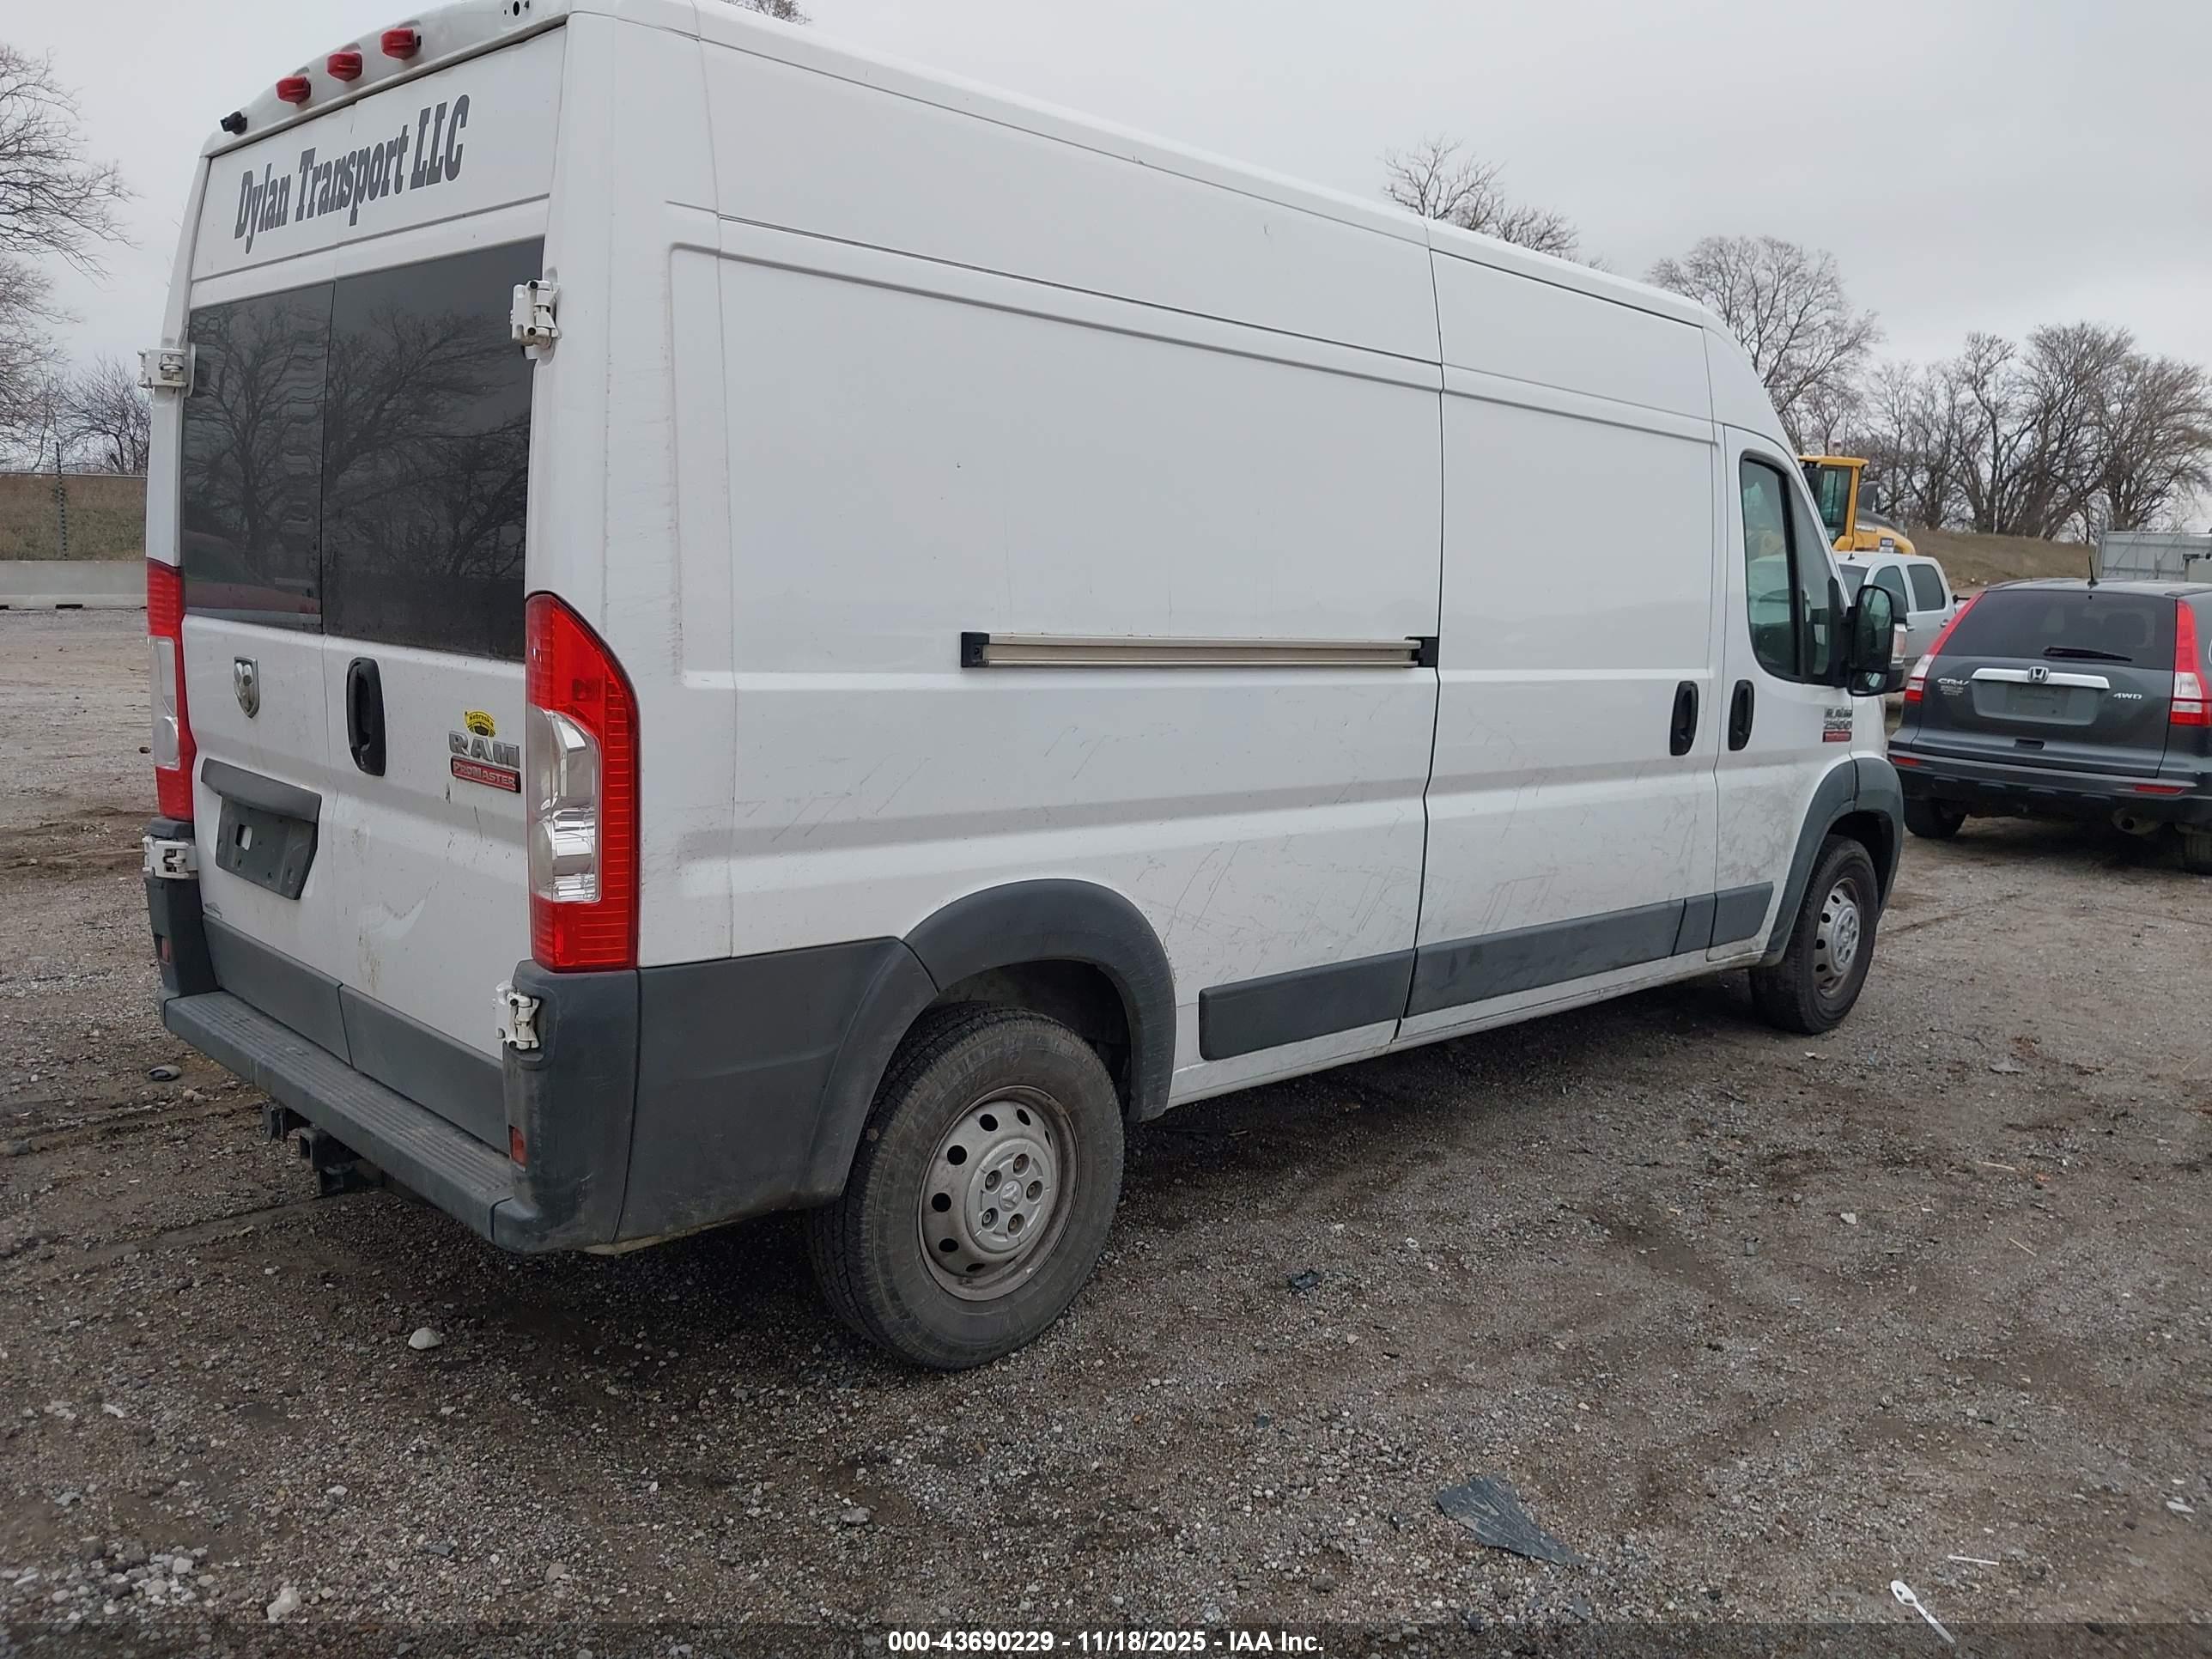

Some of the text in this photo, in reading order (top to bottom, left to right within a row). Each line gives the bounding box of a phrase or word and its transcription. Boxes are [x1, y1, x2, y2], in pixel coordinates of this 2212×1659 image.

[234, 94, 471, 254] Dylan Transport LLC
[2112, 692, 2143, 701] 4WD
[448, 730, 520, 769] RAM
